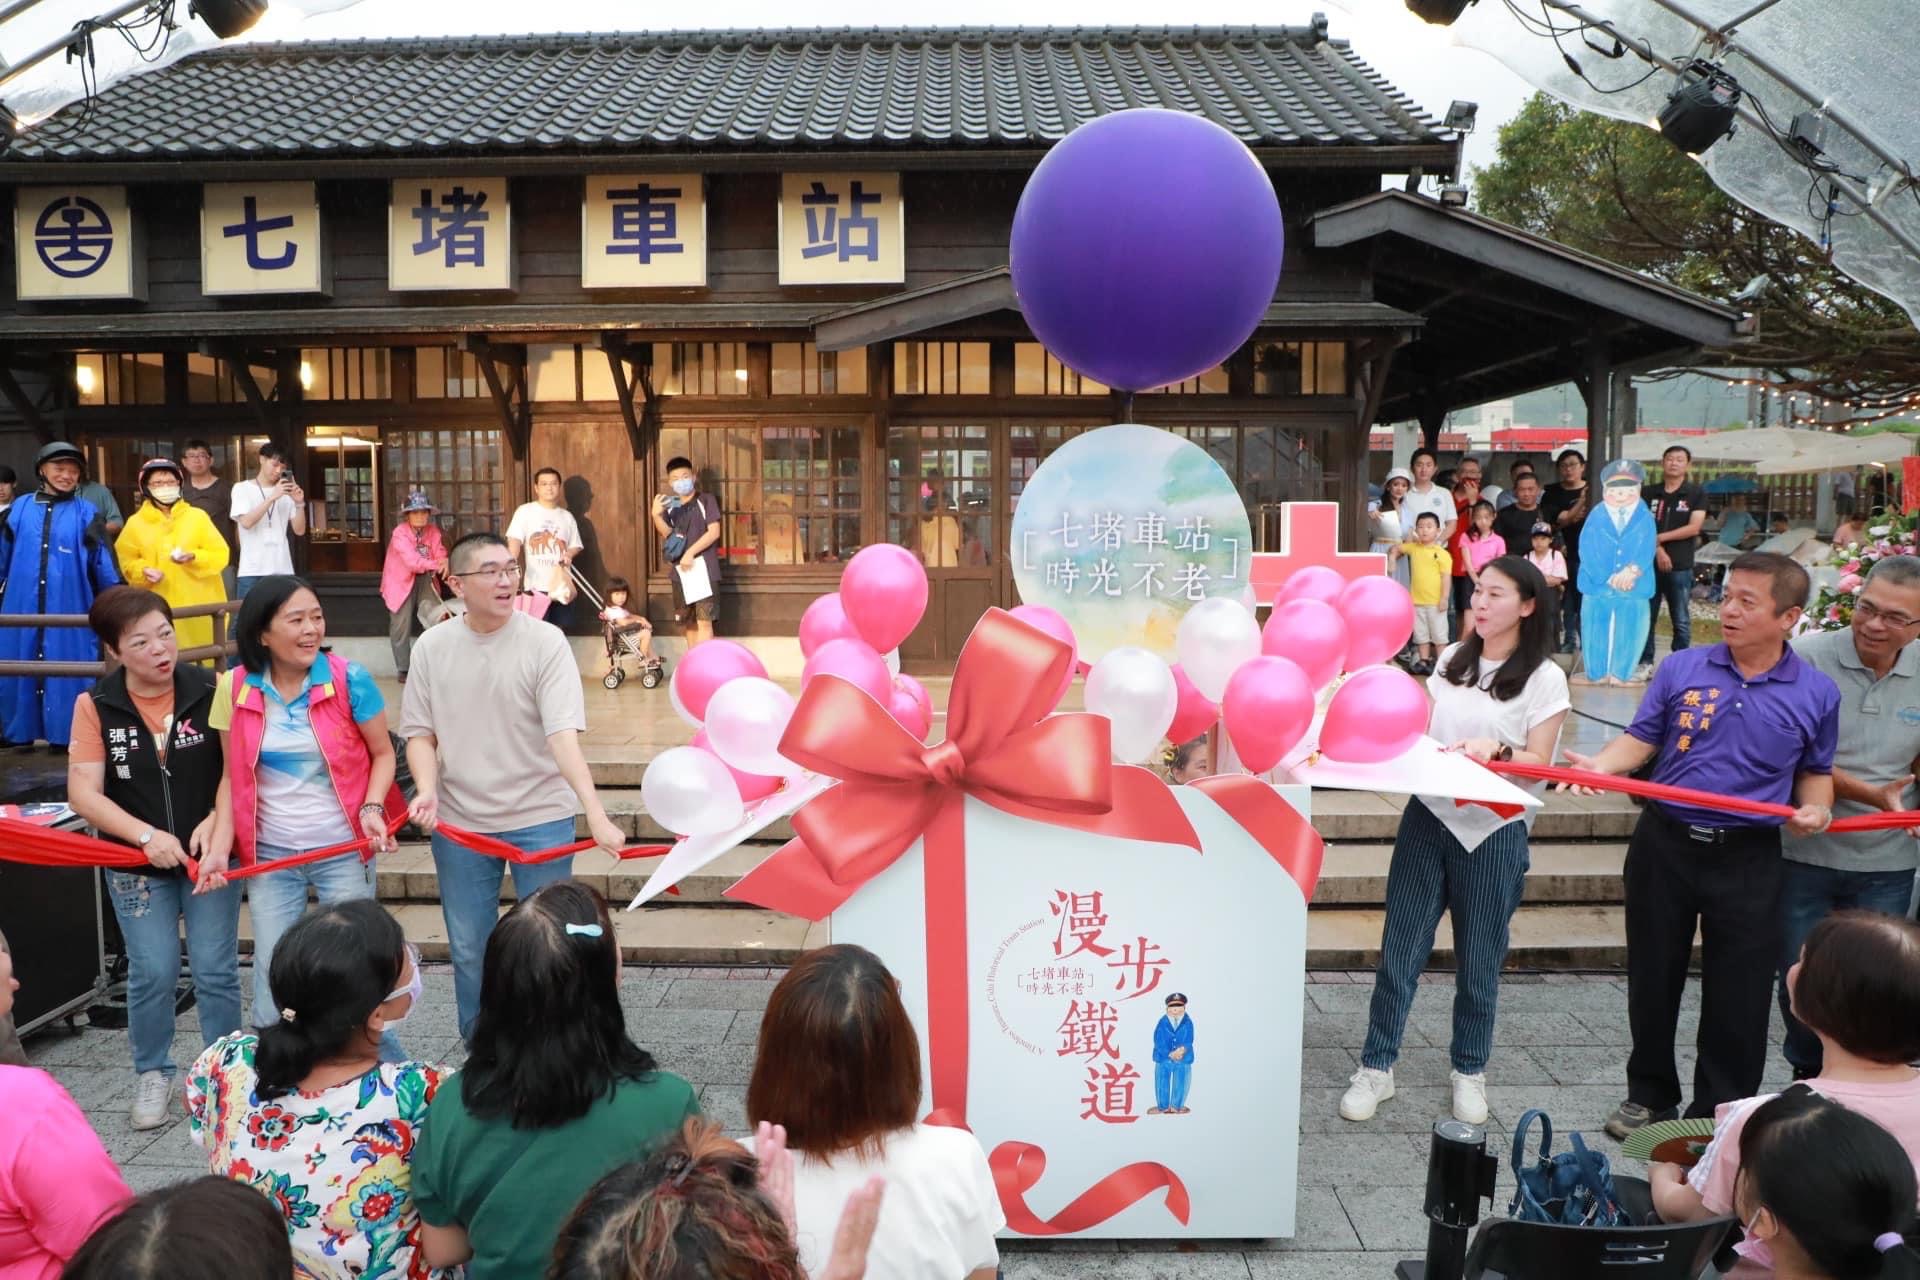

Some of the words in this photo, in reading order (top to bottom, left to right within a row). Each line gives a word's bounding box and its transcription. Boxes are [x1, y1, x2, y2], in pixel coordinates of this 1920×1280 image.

[222, 181, 882, 270] 七堵車站
[1049, 511, 1210, 552] 七堵車站
[1046, 557, 1212, 600] 時光不老
[1026, 966, 1086, 981] 七堵車站
[1026, 982, 1086, 995] 時光不老
[1047, 888, 1171, 1124] 漫步鐵道
